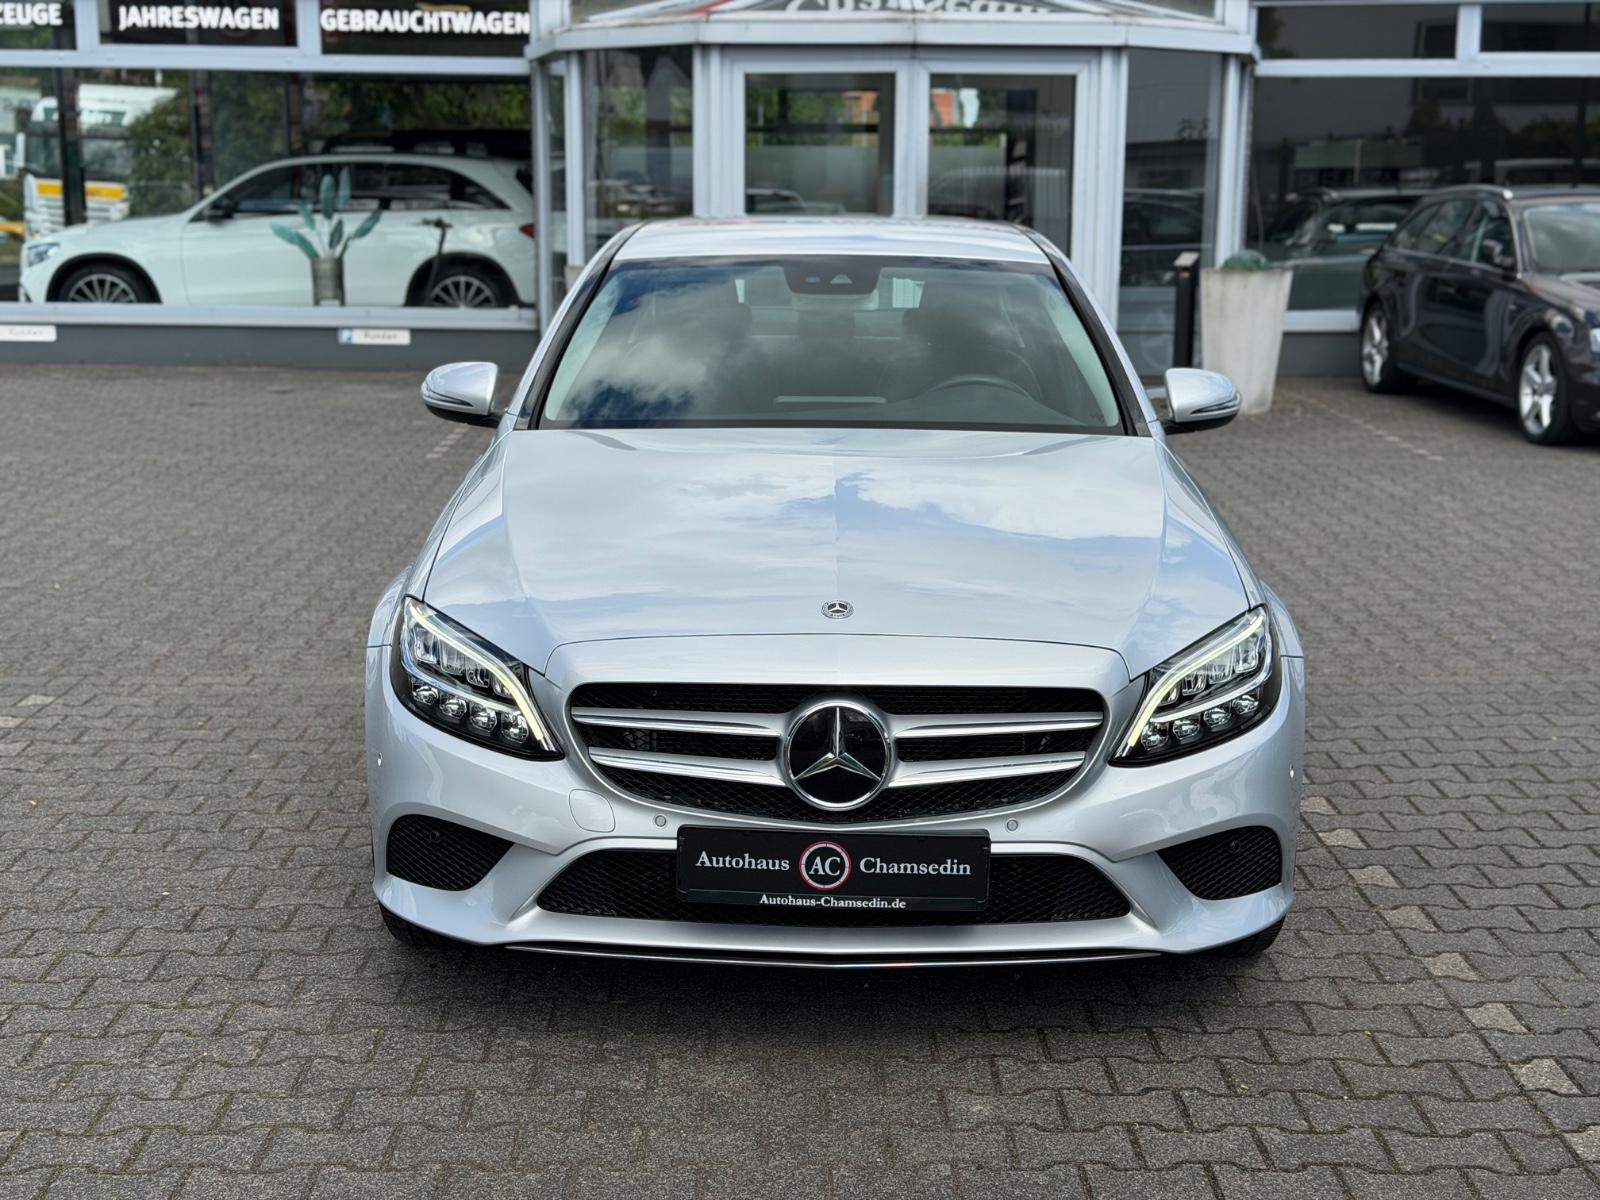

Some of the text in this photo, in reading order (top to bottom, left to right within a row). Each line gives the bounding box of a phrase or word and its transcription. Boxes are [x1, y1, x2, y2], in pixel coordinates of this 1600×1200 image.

[118, 4, 280, 31] JAHRESWAGEN
[320, 8, 530, 35] GEBRAUCHTWAGEN
[695, 851, 972, 878] Autohaus AC Chamsedin
[759, 893, 907, 910] Autohaus-Chamsedin.de
